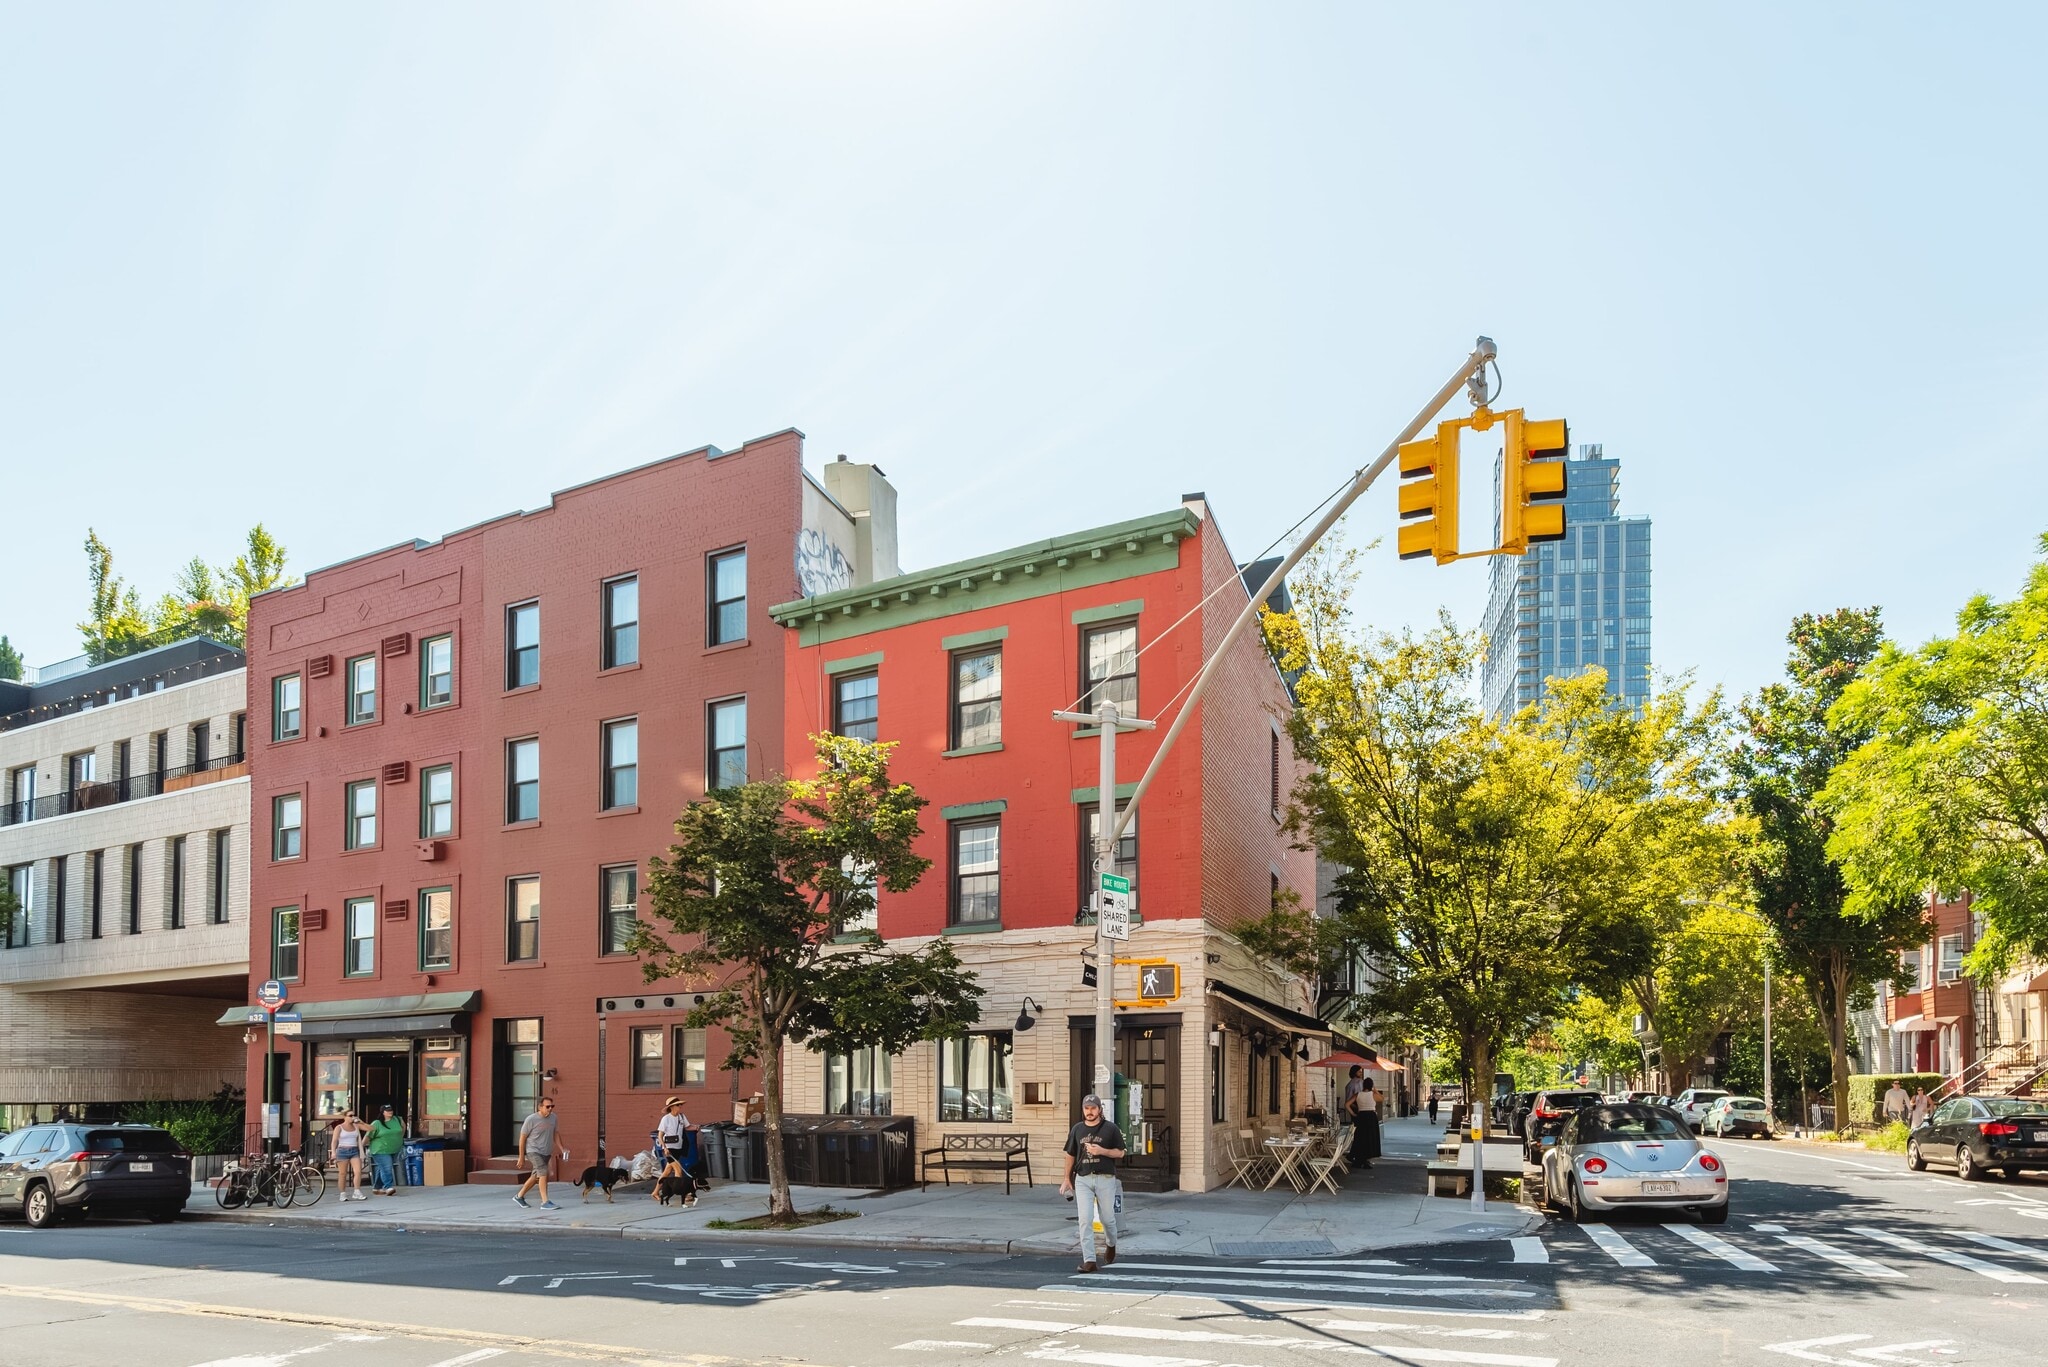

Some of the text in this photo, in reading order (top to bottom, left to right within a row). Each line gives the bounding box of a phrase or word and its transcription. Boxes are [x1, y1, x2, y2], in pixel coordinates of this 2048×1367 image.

[1103, 878, 1127, 890] BIKE ROUTE
[1103, 911, 1127, 923] SHARED
[1106, 923, 1123, 935] LANE
[1143, 1030, 1153, 1038] 47
